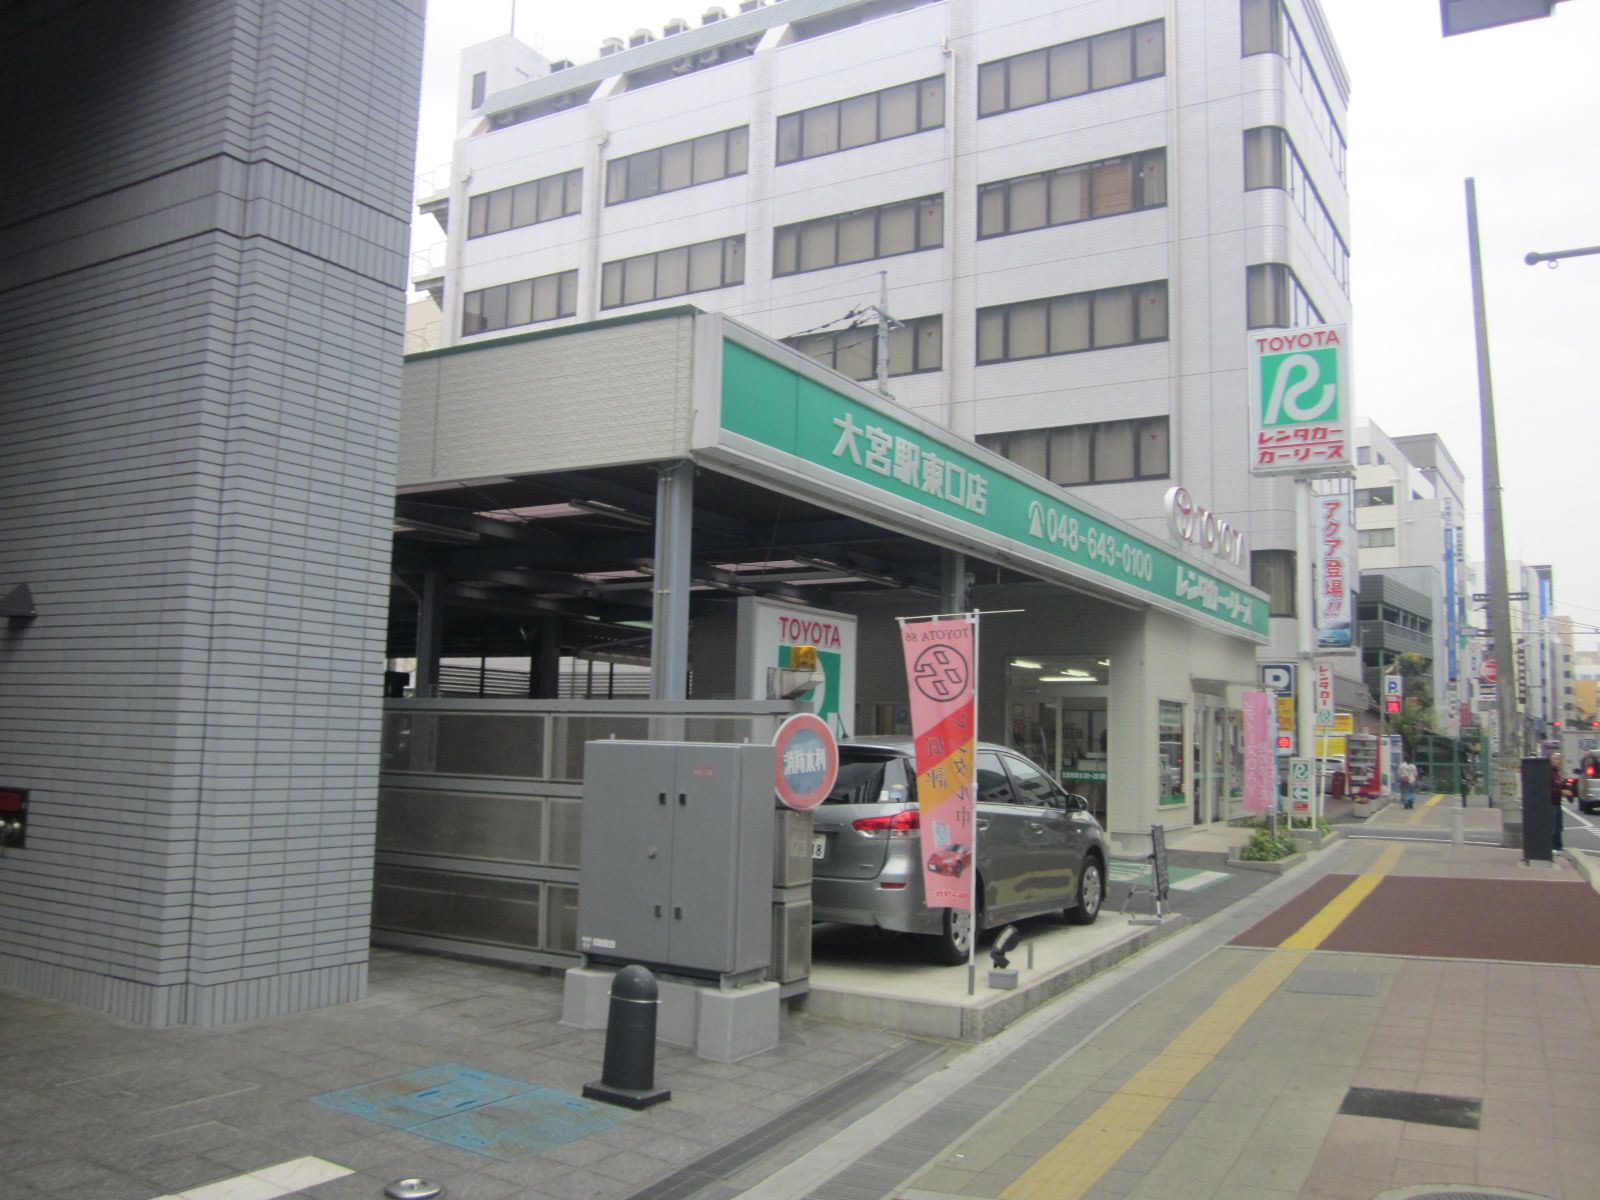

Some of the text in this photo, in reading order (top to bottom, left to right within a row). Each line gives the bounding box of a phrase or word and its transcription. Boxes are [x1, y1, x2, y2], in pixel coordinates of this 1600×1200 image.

[1256, 329, 1341, 353] TOYOTA
[1258, 426, 1344, 445] レンタカー
[832, 411, 989, 517] 大宮駅東口店
[1258, 446, 1344, 466] カーリース
[1047, 506, 1154, 583] 048-643-0100
[780, 616, 841, 647] TOYOTA
[1388, 681, 1398, 694] P
[783, 747, 827, 776] 消防水利
